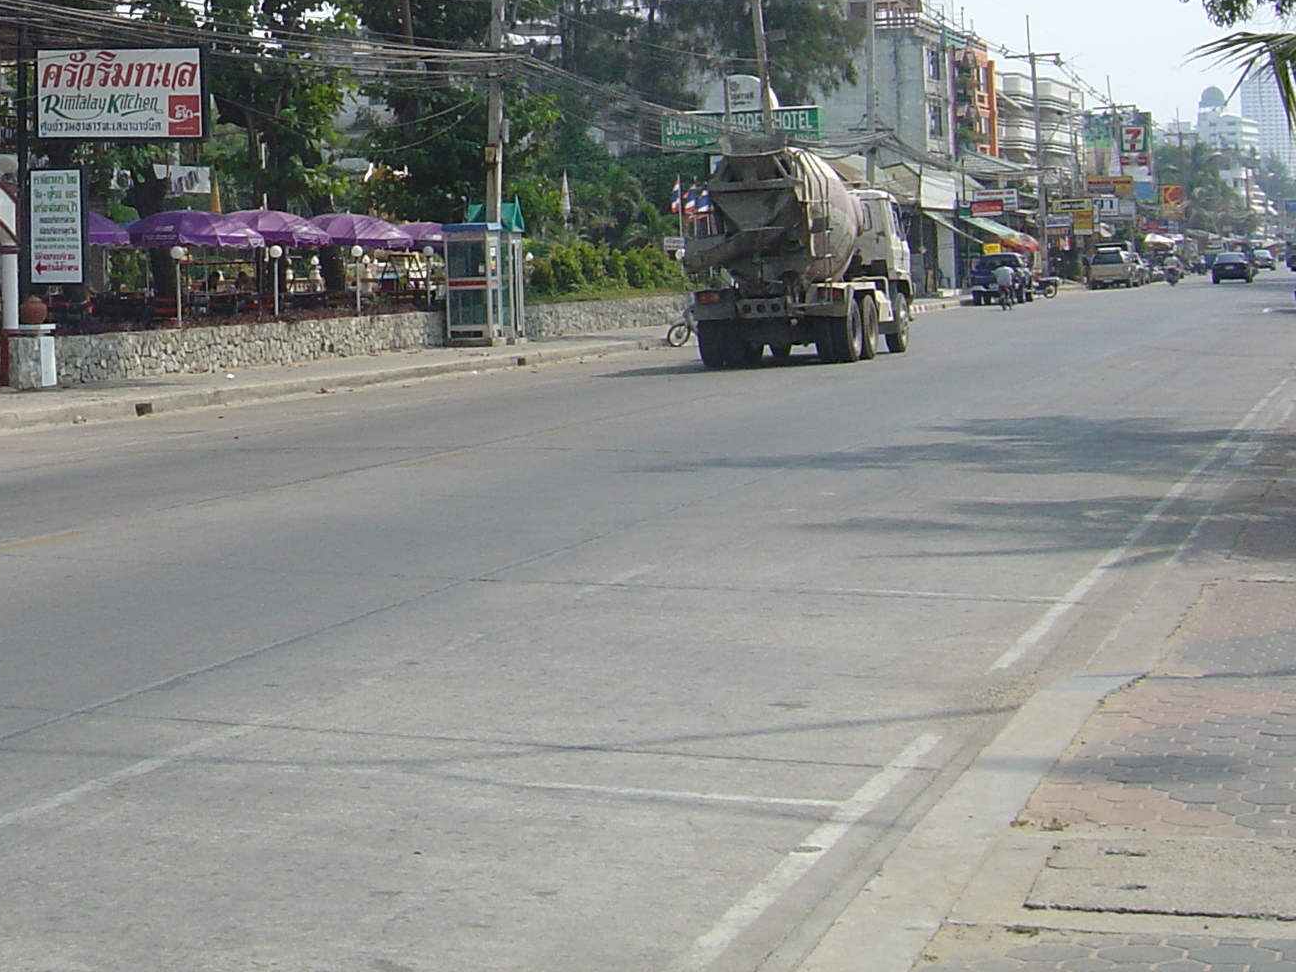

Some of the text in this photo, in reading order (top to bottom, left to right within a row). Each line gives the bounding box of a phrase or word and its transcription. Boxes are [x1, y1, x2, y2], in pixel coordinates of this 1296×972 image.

[41, 51, 199, 91] ครัวริมทะเล
[41, 93, 163, 119] Rimtalay Kitchen
[774, 111, 813, 130] HOTEL
